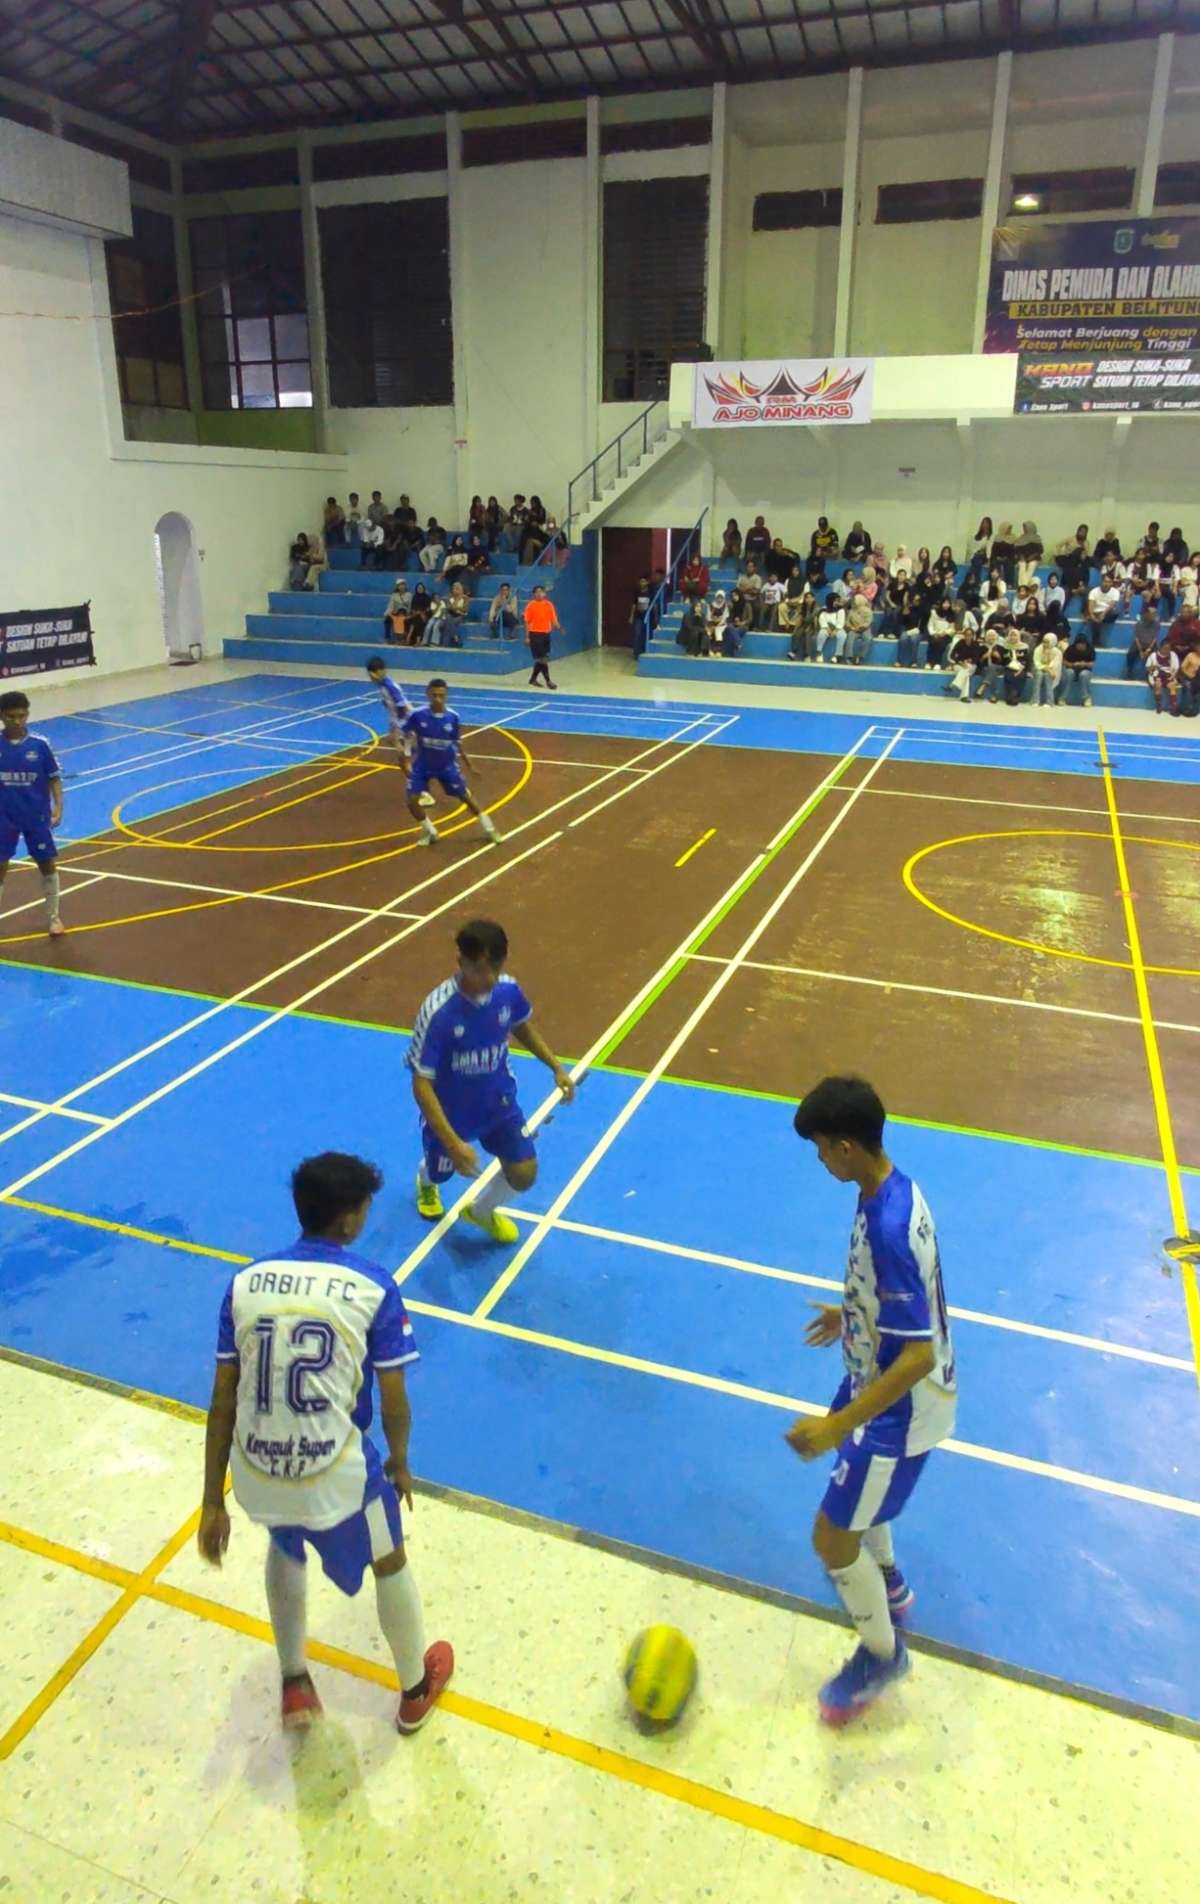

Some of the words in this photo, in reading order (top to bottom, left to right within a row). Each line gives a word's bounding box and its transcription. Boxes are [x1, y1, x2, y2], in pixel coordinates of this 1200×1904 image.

[1002, 269, 1048, 300] DINAS
[1050, 267, 1114, 300] PEMUDA
[1116, 265, 1150, 298] DAN
[1016, 302, 1116, 317] KABUPATEN
[1016, 325, 1072, 339] Selamat
[1075, 327, 1139, 340] Berjuang
[1142, 326, 1198, 340] dengan
[1060, 338, 1143, 352] Menjunjung
[1147, 337, 1192, 351] Tinggi
[1096, 360, 1135, 373] DESIGN
[1039, 375, 1094, 389] SPORT
[1092, 375, 1133, 388] SATUAN
[1132, 374, 1164, 388] TETAP
[713, 405, 761, 421] AJO
[763, 402, 852, 420] MINANG
[249, 1272, 317, 1295] ORBIT
[326, 1278, 357, 1301] FC
[252, 1315, 336, 1416] 12
[298, 1435, 336, 1463] Super
